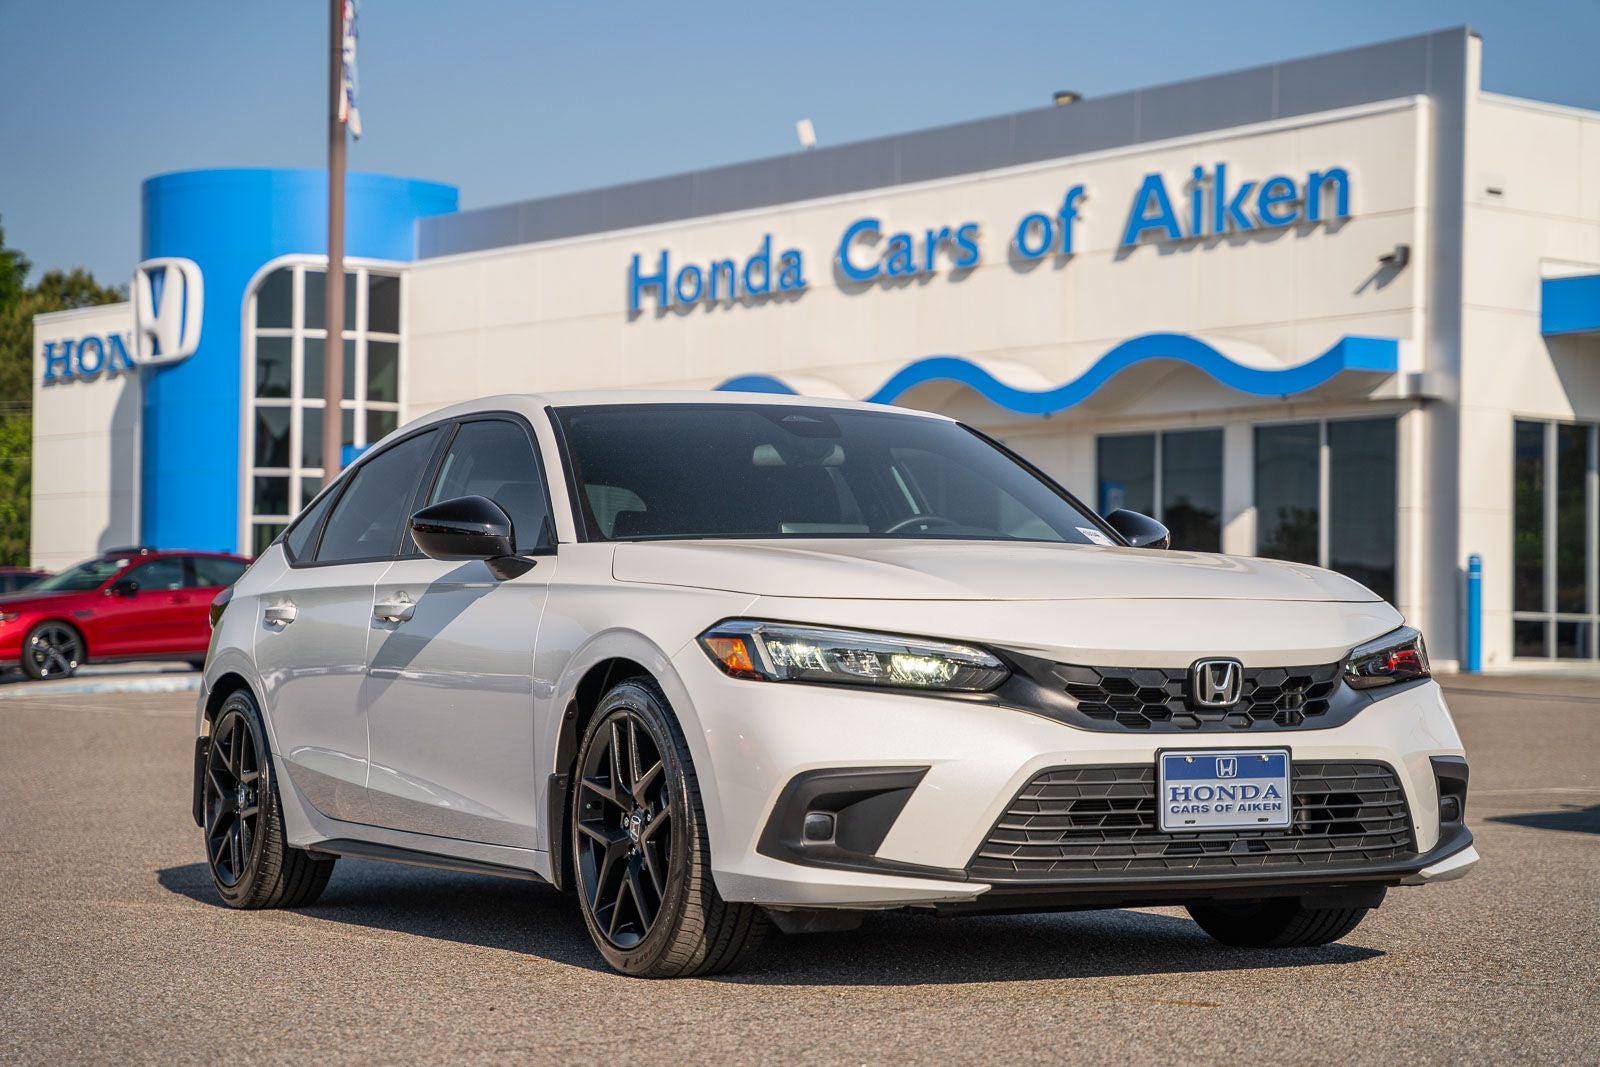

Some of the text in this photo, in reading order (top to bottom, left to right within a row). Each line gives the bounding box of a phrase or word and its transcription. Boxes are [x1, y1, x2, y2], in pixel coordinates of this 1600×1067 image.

[629, 162, 1350, 311] Honda Cars of Aiken
[1169, 784, 1282, 802] HONDA
[1170, 802, 1282, 815] CARS OF AIKEN
